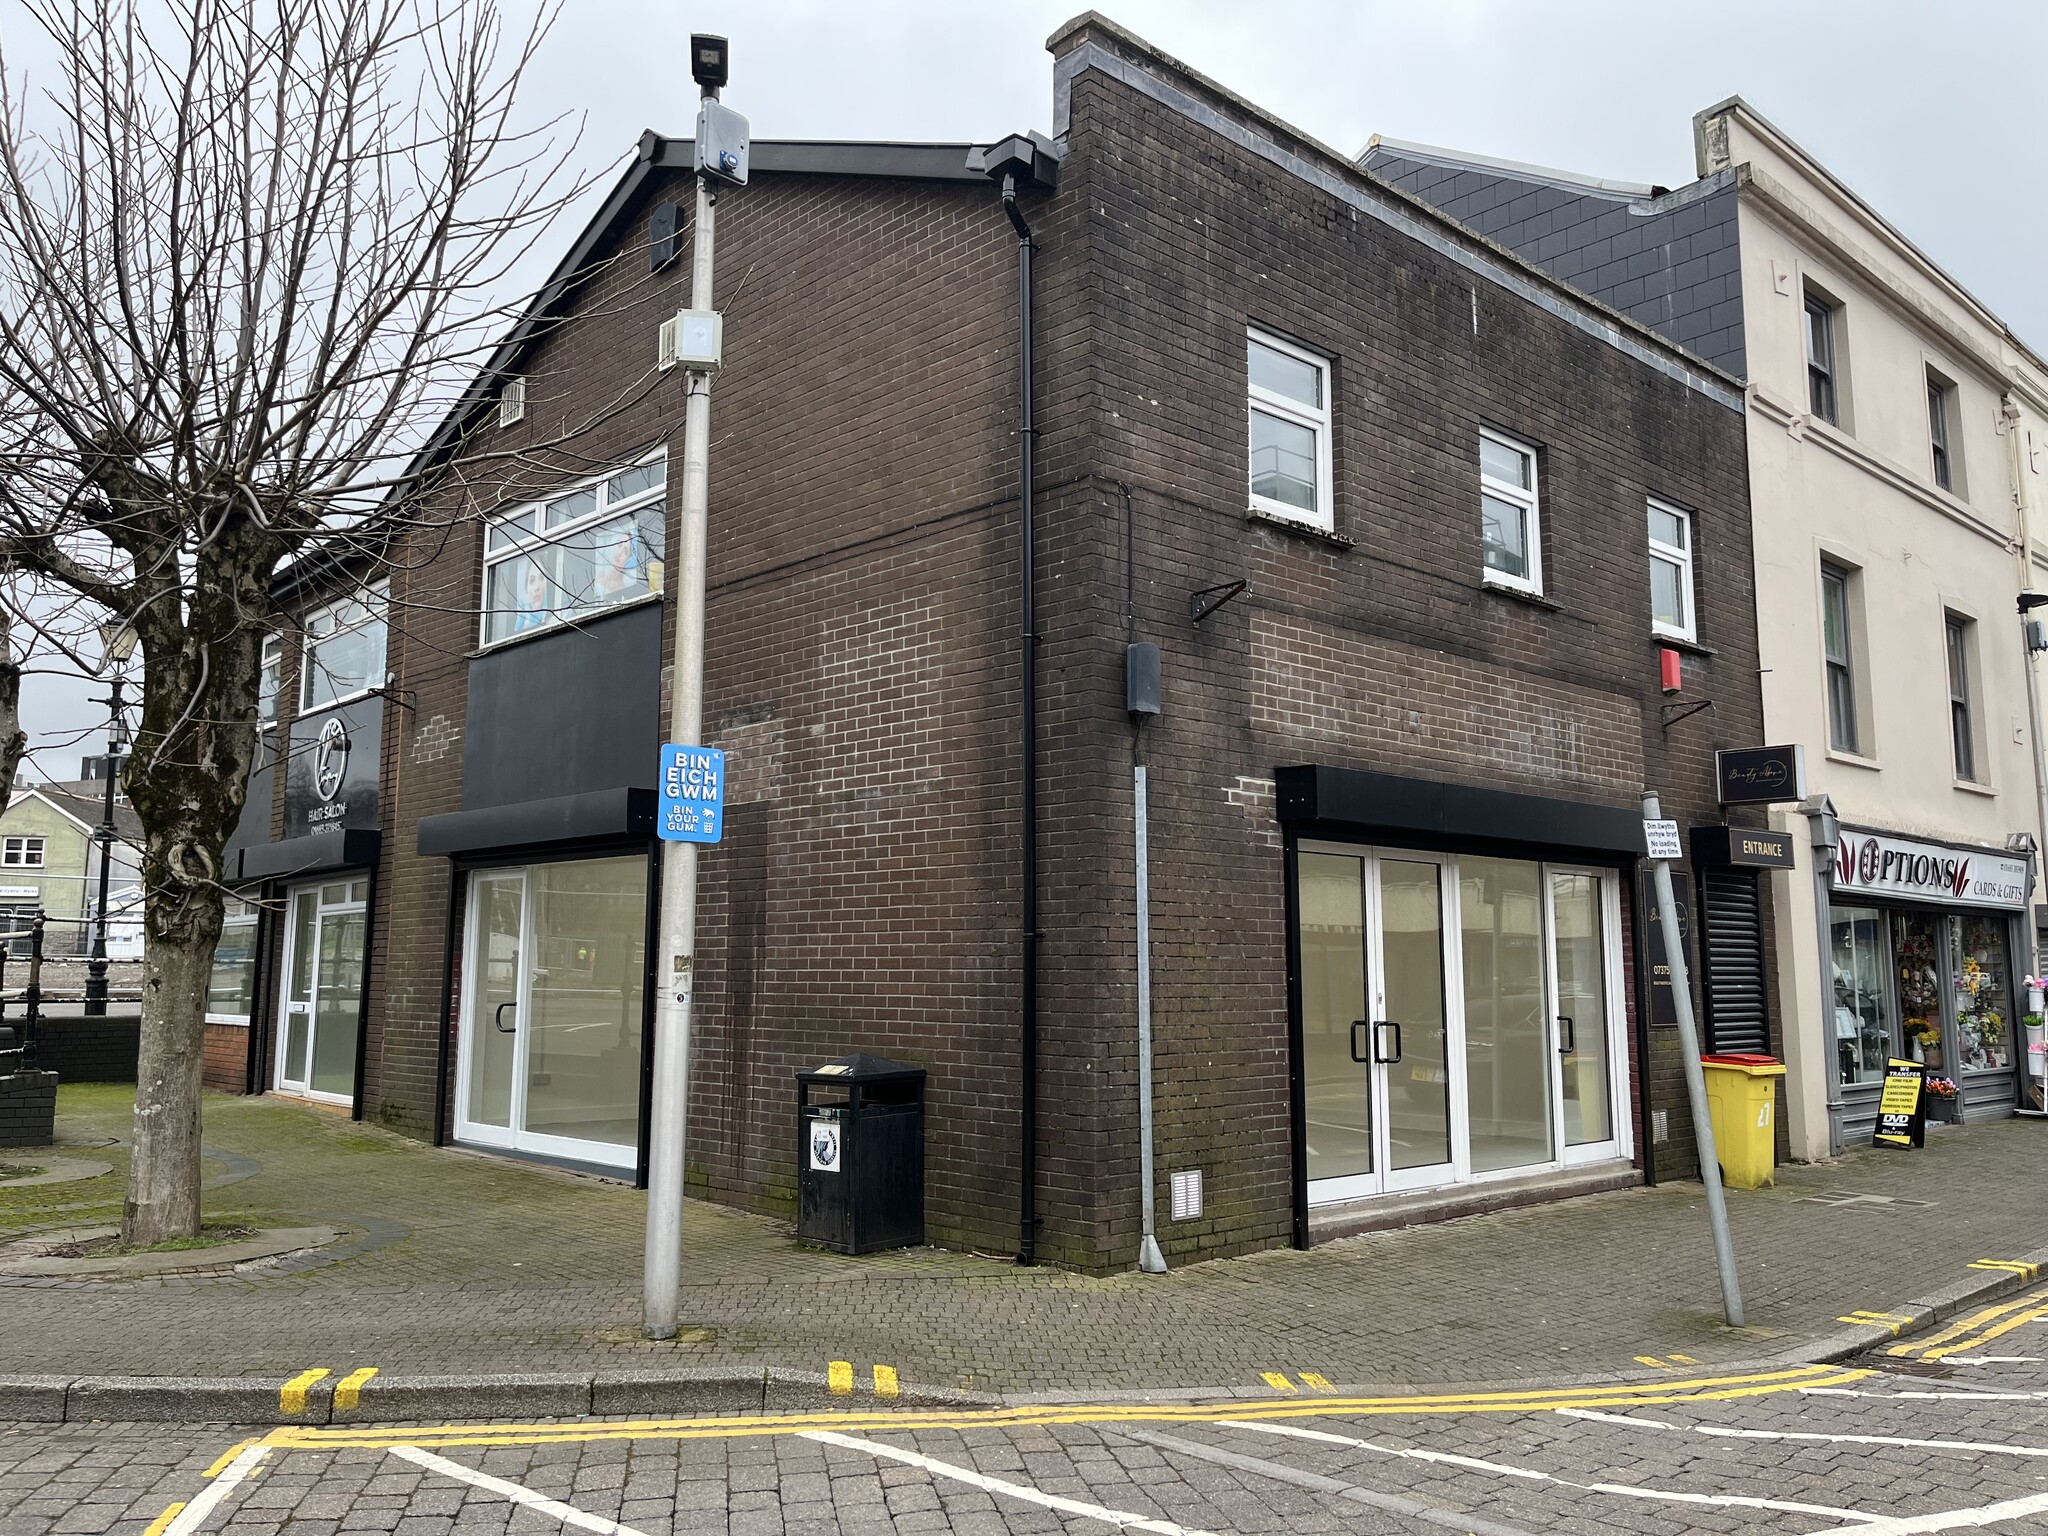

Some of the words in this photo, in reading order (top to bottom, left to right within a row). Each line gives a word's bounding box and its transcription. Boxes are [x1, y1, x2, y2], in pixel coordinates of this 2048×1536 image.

[675, 752, 710, 770] BIN
[666, 767, 717, 786] EICH
[665, 783, 717, 801] GWM
[666, 813, 699, 824] YOUR
[673, 805, 693, 815] BIN
[667, 822, 697, 832] GUM.
[1659, 840, 1677, 848] loading
[1743, 840, 1782, 857] ENTRANCE
[1861, 837, 1955, 889] OPTIONS
[1973, 880, 1997, 898] CARDS
[1997, 884, 2002, 898] &
[2003, 884, 2023, 900] GIFTS
[1882, 1114, 1909, 1123] DVD
